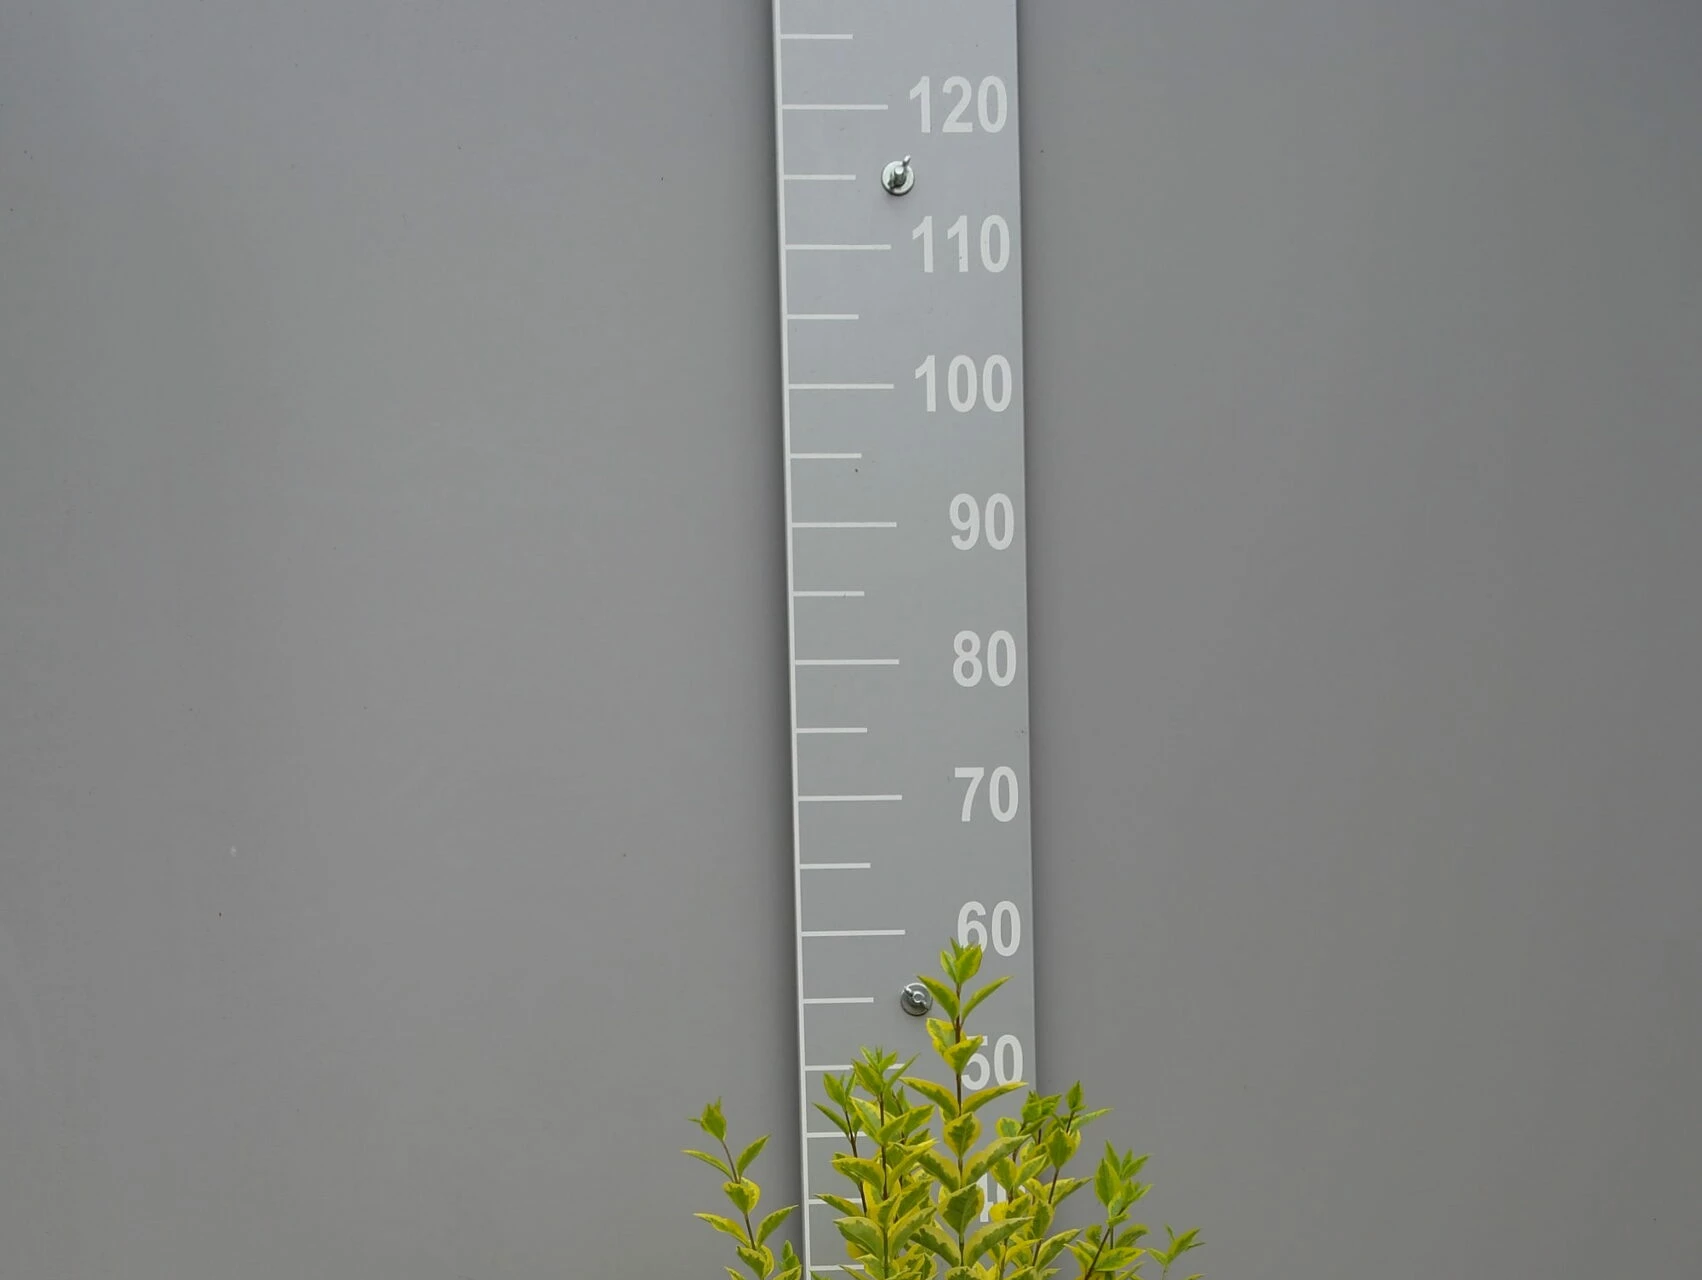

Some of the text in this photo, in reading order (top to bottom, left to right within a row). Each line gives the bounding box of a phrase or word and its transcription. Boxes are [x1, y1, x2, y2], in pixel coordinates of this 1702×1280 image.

[909, 75, 1008, 133] 120
[912, 214, 1010, 273] 110
[915, 354, 1012, 413] 100
[949, 492, 1015, 551] 90
[952, 630, 1017, 688] 80
[954, 765, 1019, 823] 70
[957, 900, 1021, 957] 60
[961, 1034, 1024, 1091] 50
